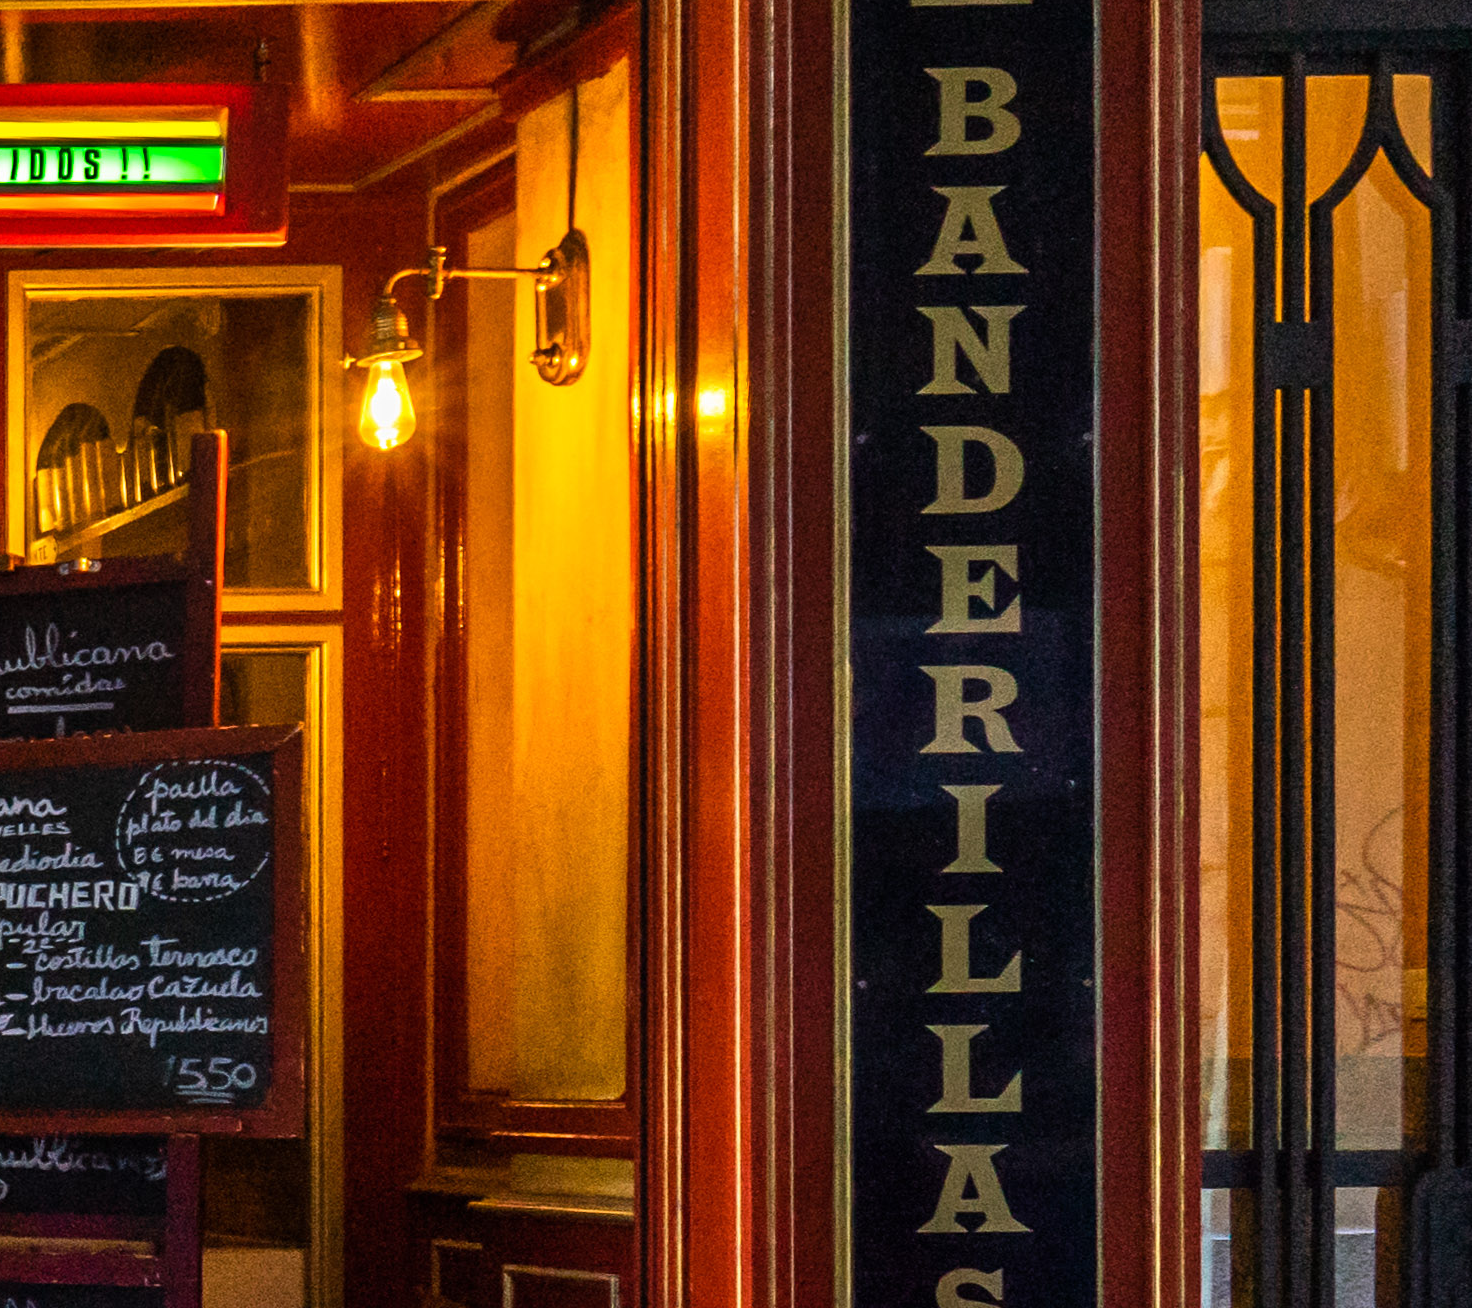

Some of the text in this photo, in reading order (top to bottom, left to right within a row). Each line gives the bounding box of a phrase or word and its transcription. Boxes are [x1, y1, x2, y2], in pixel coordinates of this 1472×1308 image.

[5, 672, 127, 701] comidas
[143, 770, 245, 816] paella
[126, 809, 183, 846] plato
[187, 804, 219, 830] del
[169, 847, 237, 862] mesa
